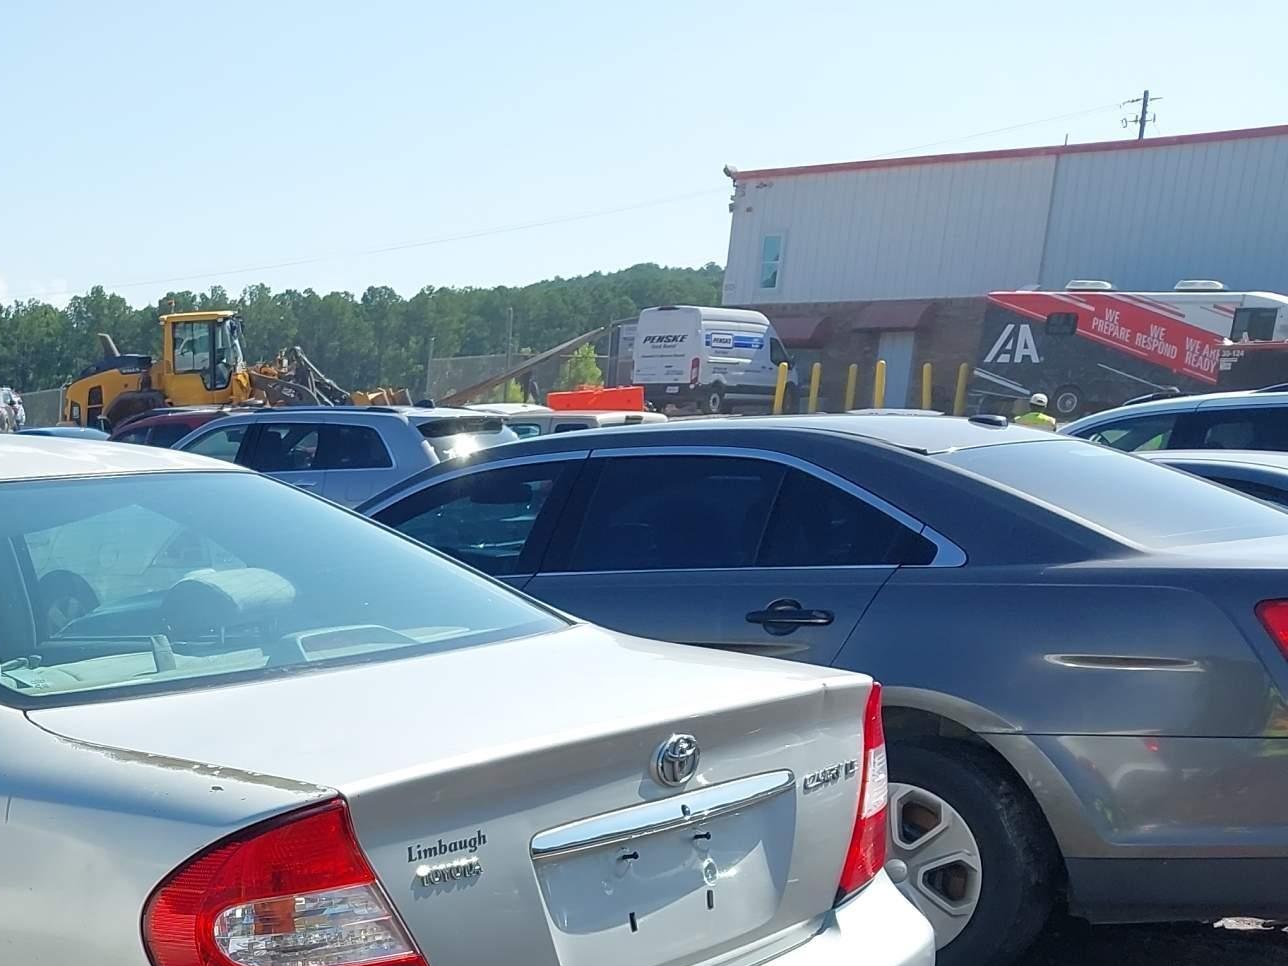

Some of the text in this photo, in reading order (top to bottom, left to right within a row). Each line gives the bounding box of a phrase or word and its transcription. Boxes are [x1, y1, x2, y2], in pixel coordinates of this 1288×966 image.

[1105, 308, 1121, 325] WE
[1092, 316, 1131, 342] PREPARE
[1150, 324, 1166, 341] WE
[642, 334, 689, 345] PENSKE
[1135, 332, 1178, 360] RESPOND
[1185, 336, 1201, 354] WE
[1184, 351, 1217, 373] READY
[407, 829, 487, 863] Limbaugh
